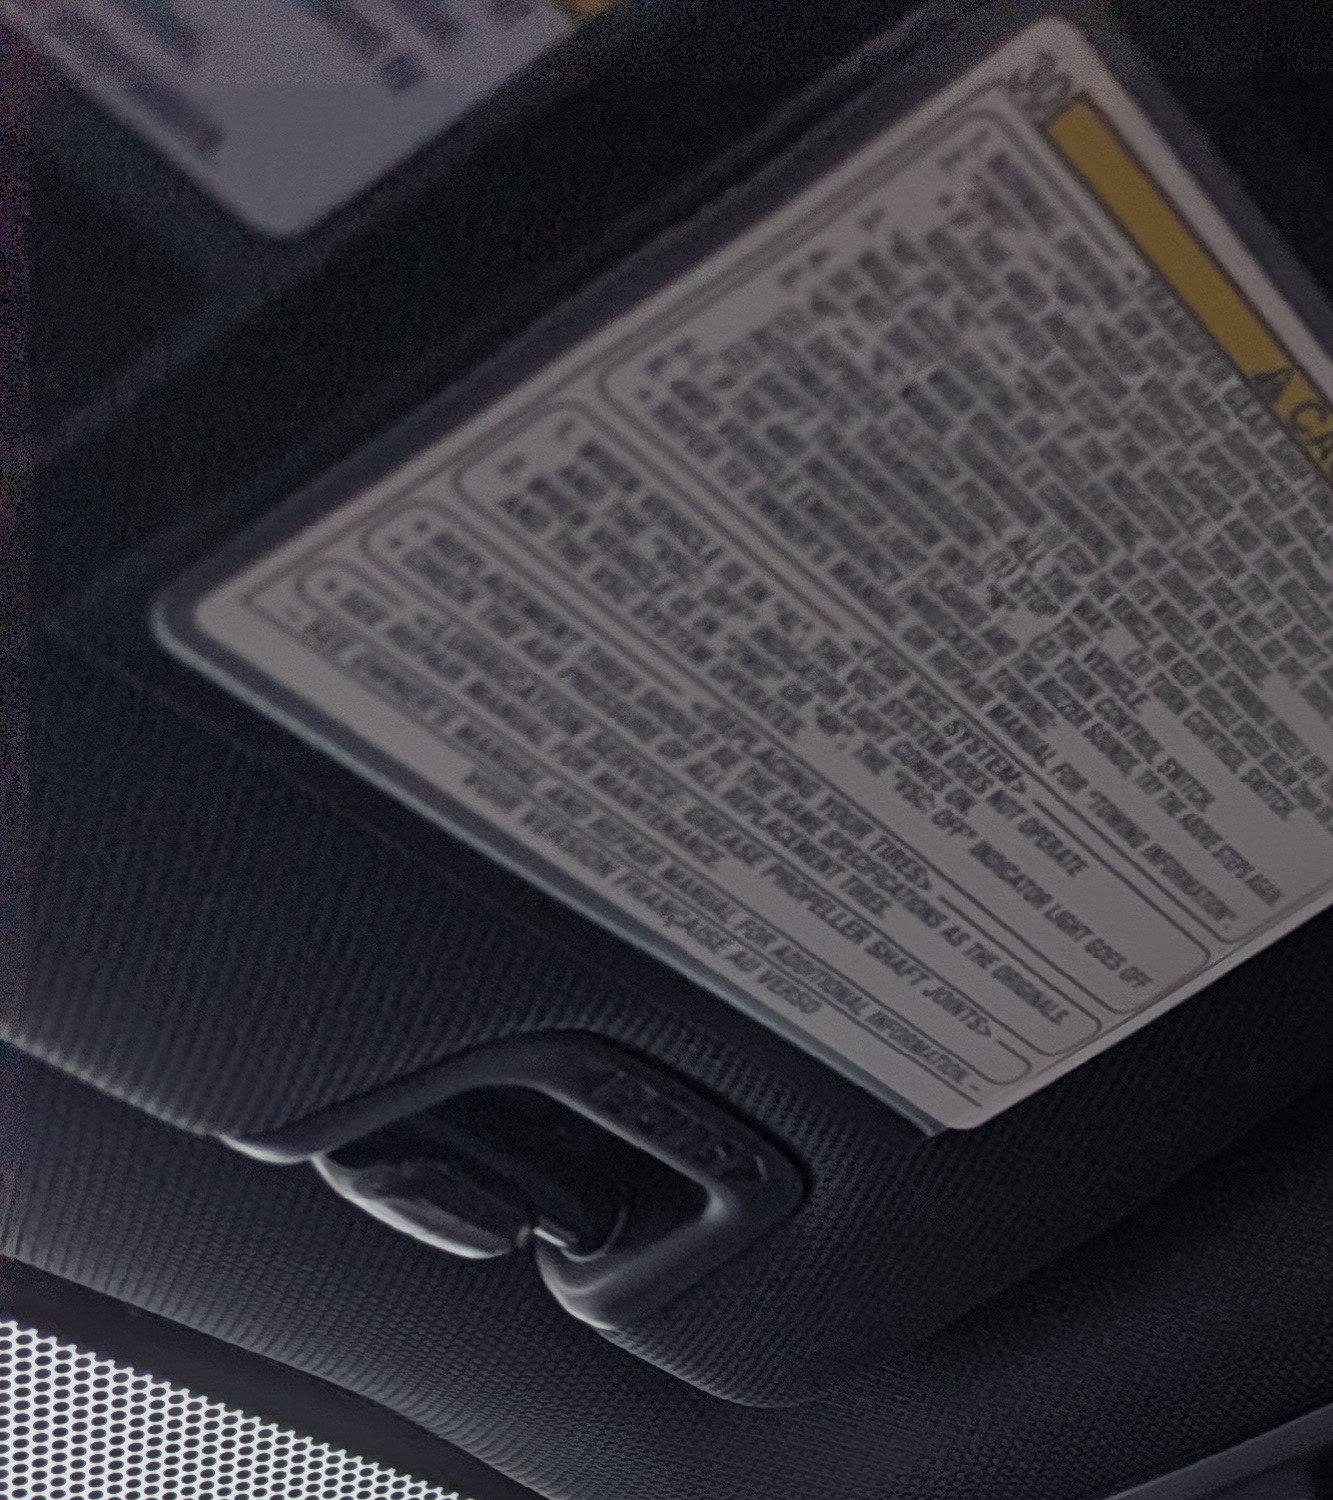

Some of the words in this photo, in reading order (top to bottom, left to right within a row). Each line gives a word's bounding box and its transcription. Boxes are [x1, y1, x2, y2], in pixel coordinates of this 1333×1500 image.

[688, 698, 822, 800] <REPLACING
[813, 796, 873, 840] YOUR
[864, 835, 939, 892] TIRES>
[846, 636, 909, 687] <FOR
[939, 717, 1032, 795] SYSTEM>
[459, 769, 524, 813] VOIR
[516, 808, 619, 878] VERSION
[611, 873, 730, 953] FRANÇAISE
[754, 970, 821, 1015] VERSO
